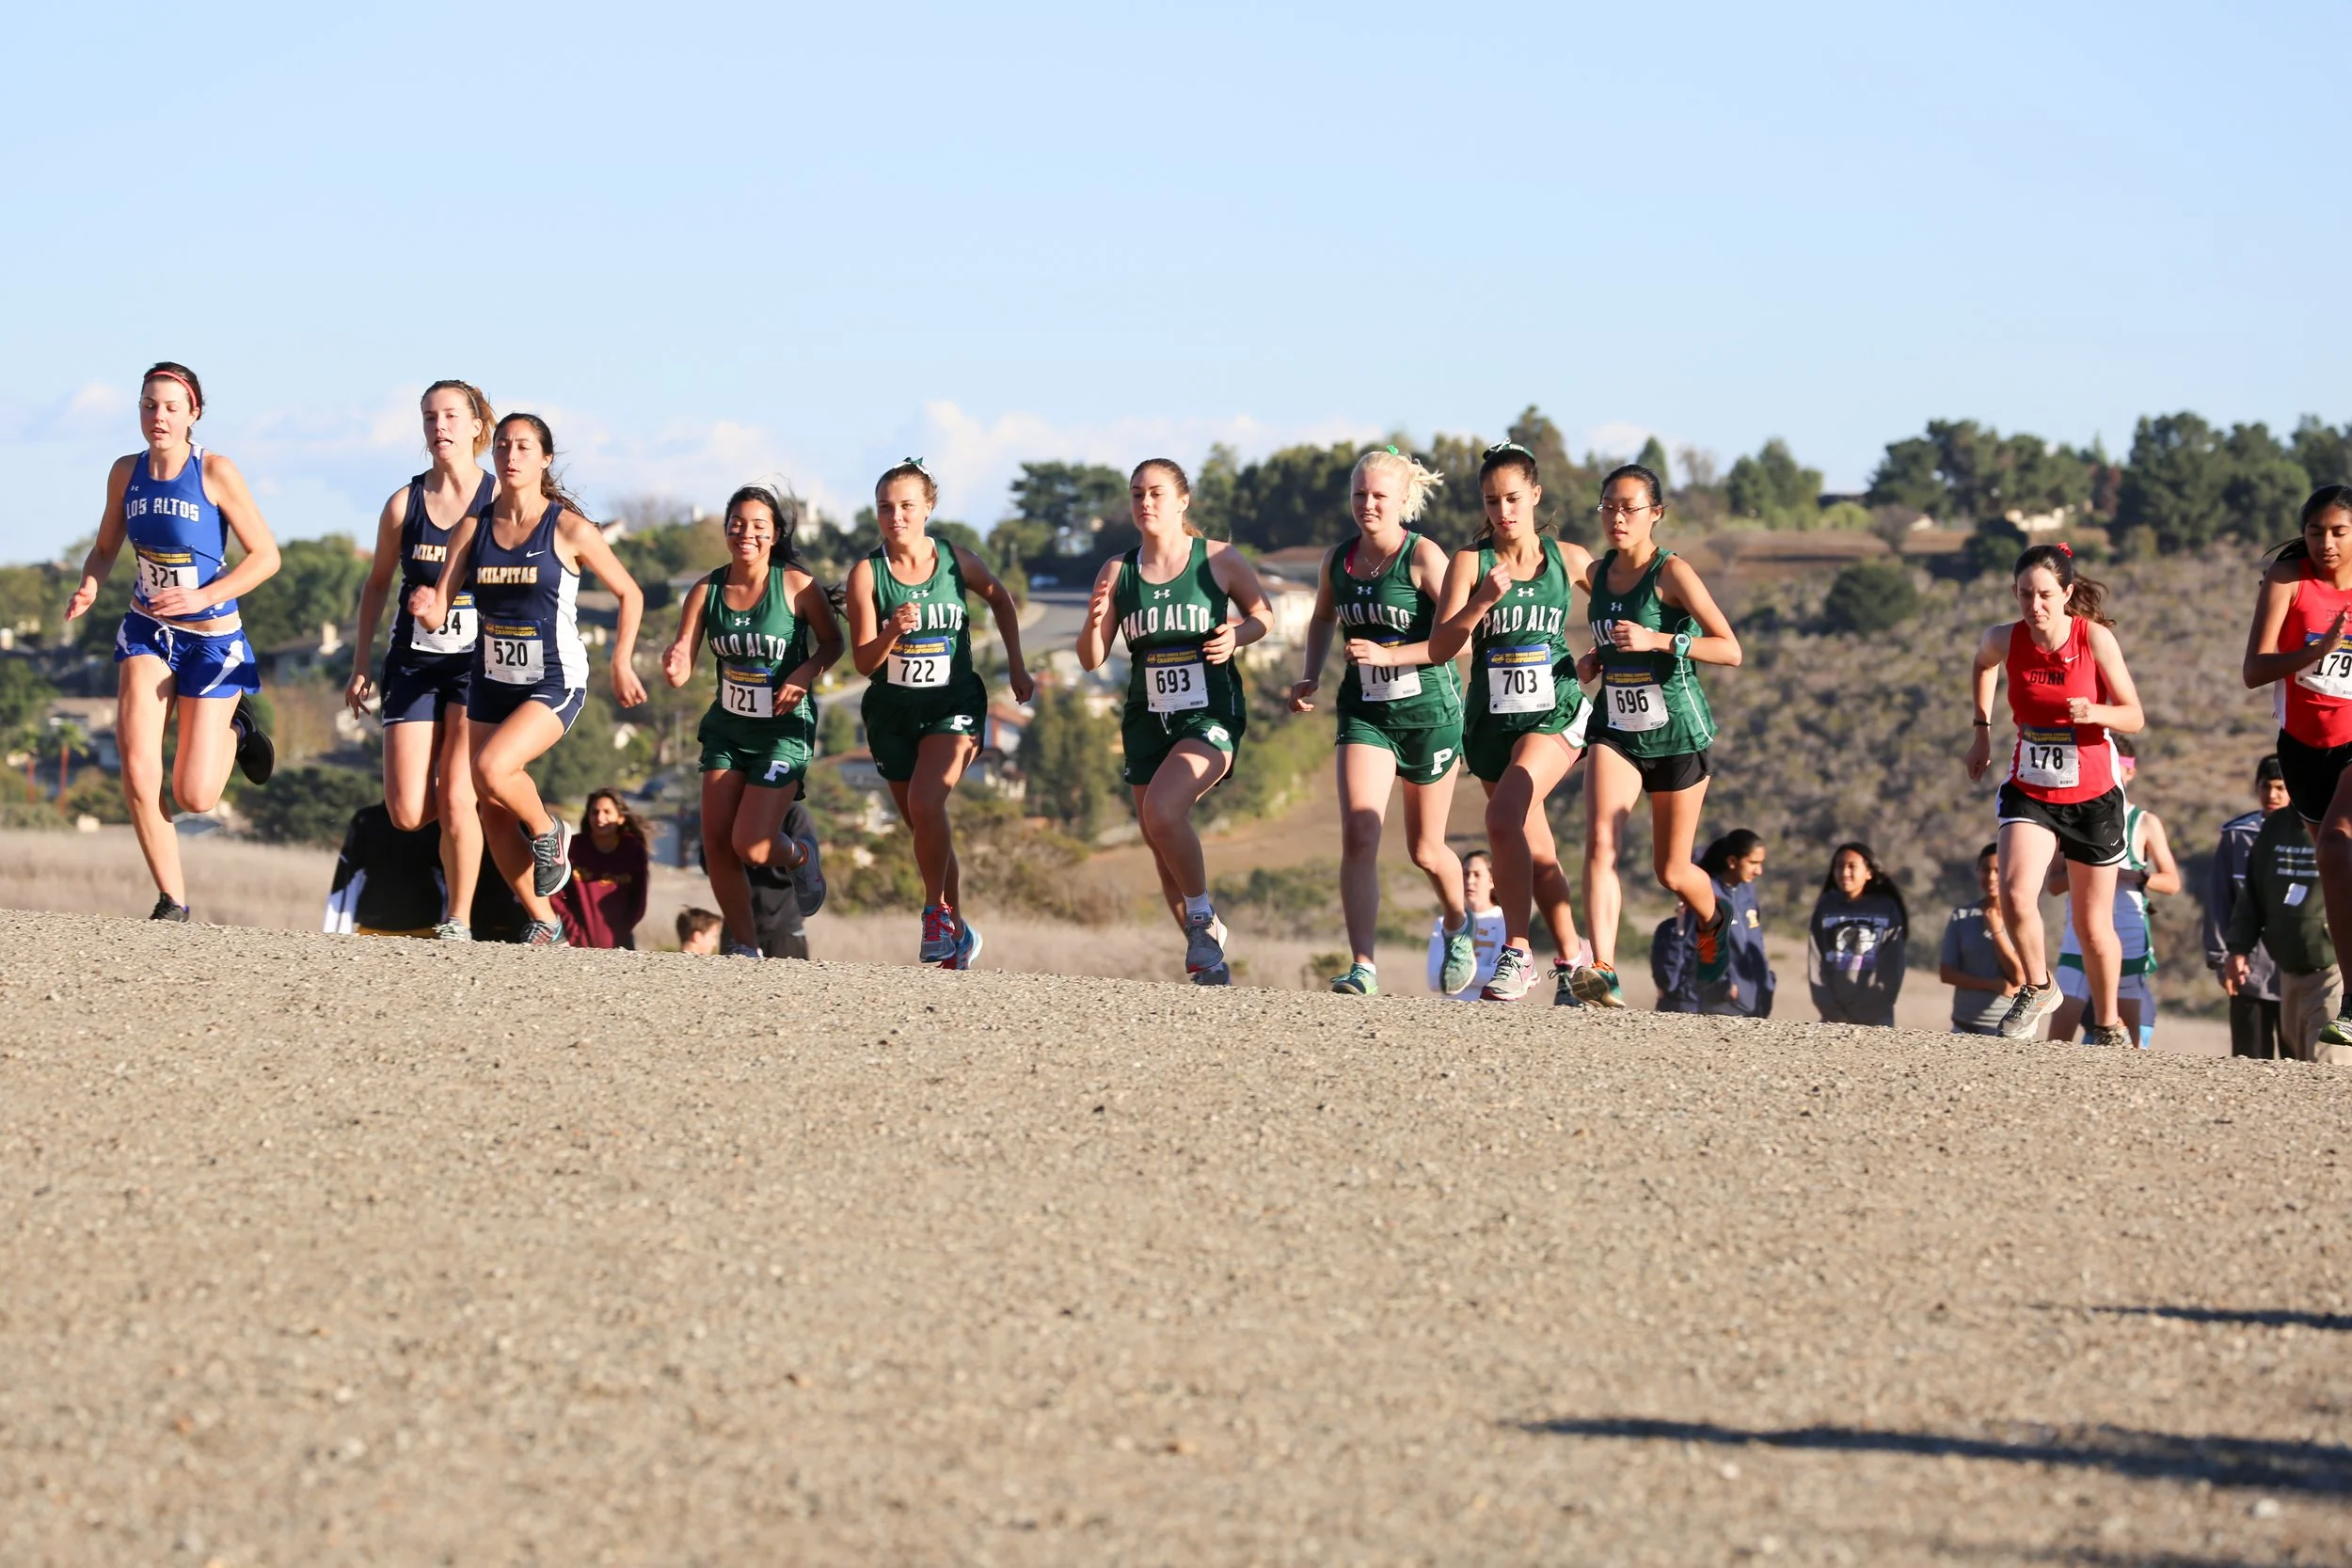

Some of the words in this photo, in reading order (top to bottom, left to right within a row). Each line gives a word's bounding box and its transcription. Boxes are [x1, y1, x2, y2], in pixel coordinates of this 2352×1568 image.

[126, 498, 147, 519] LOS
[152, 498, 200, 522] ALTOS
[412, 544, 447, 562] MILPI
[149, 564, 180, 589] 321
[476, 566, 538, 584] MILPITAS
[1122, 607, 1159, 641] PALO
[1164, 603, 1210, 633] ALTO
[1368, 603, 1411, 629] ALTO
[1483, 605, 1523, 639] PALO
[1526, 605, 1563, 635] ALTO
[493, 641, 529, 667] 520
[746, 632, 787, 660] ALTO
[899, 659, 935, 683] 722
[2029, 670, 2066, 685] GUNN
[2312, 654, 2352, 678] 179
[1155, 668, 1191, 694] 693
[1502, 669, 1538, 695] 703
[729, 686, 758, 713] 721
[1615, 689, 1649, 714] 696
[950, 714, 973, 731] P
[1430, 748, 1454, 776] P
[2029, 746, 2064, 769] 178
[763, 760, 790, 782] P
